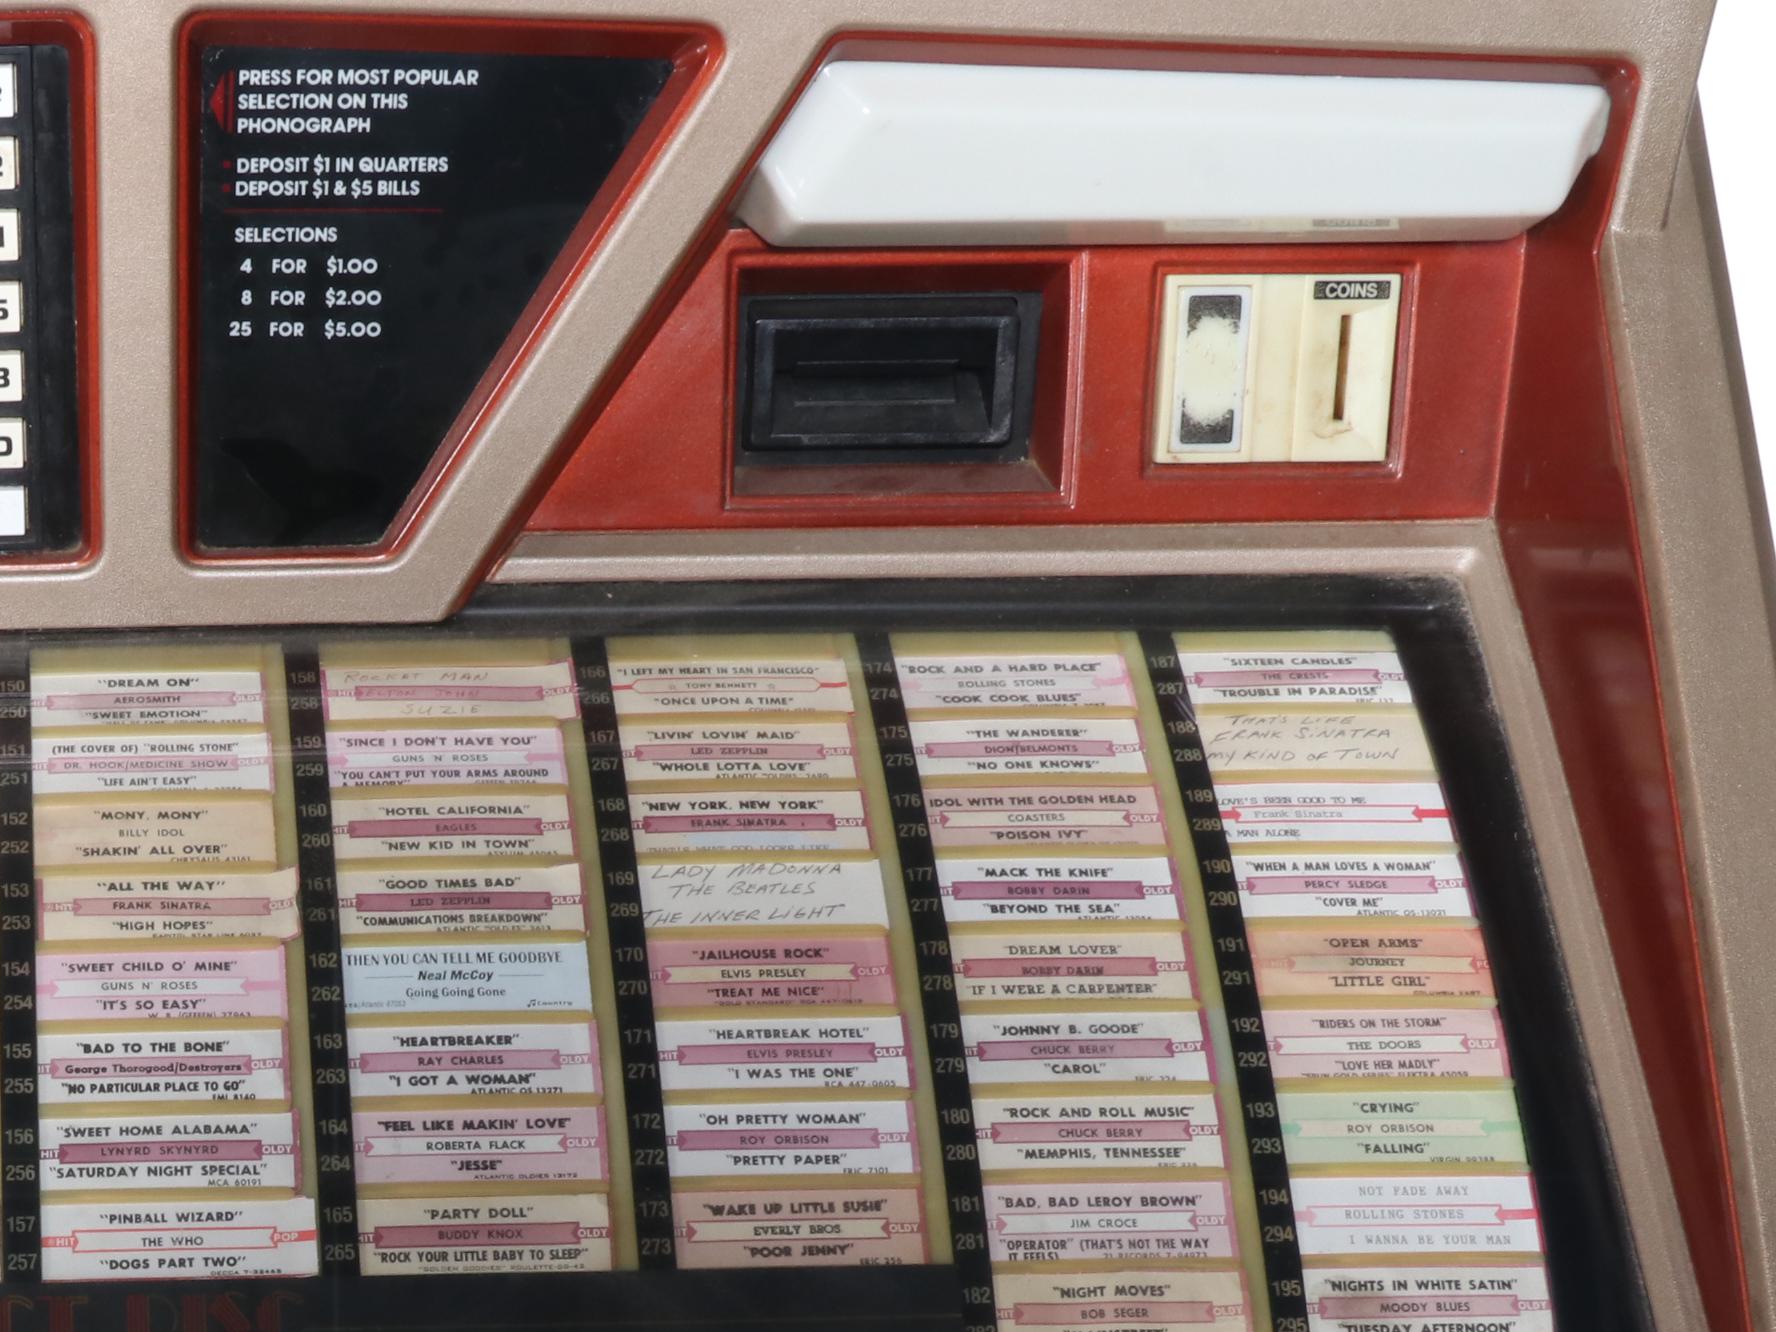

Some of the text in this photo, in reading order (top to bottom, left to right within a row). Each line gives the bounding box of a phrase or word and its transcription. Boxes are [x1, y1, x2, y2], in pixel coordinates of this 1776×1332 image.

[238, 69, 479, 86] PRESS FOR MOST POPULAR
[238, 93, 408, 110] SELECTION ON THIS
[237, 117, 371, 134] PHONOGRAPH
[236, 153, 449, 176] DEPOSIT $1 IN QUARTERS
[235, 178, 420, 199] DEPOSIT $1 & $5 BILLS
[234, 226, 338, 243] SELECTIONS
[239, 255, 378, 277] 4 FOR $1.00
[241, 286, 382, 308] 8 FOR $2.00
[1325, 282, 1378, 299] COINS
[229, 318, 382, 340] 25 FOR $5.00
[1007, 813, 1065, 823] COASTERS
[669, 880, 816, 900] THE BEATLES
[346, 951, 564, 967] THEN YOU CAN TELL ME GOODBYE
[417, 969, 494, 983] Neal McCoy
[720, 968, 806, 979] ELVIS PRESLEY
[405, 986, 506, 1000] Going Going Gone
[1346, 1123, 1435, 1134] ROY ORBISON
[426, 1139, 526, 1151] ROBERTA FLACK
